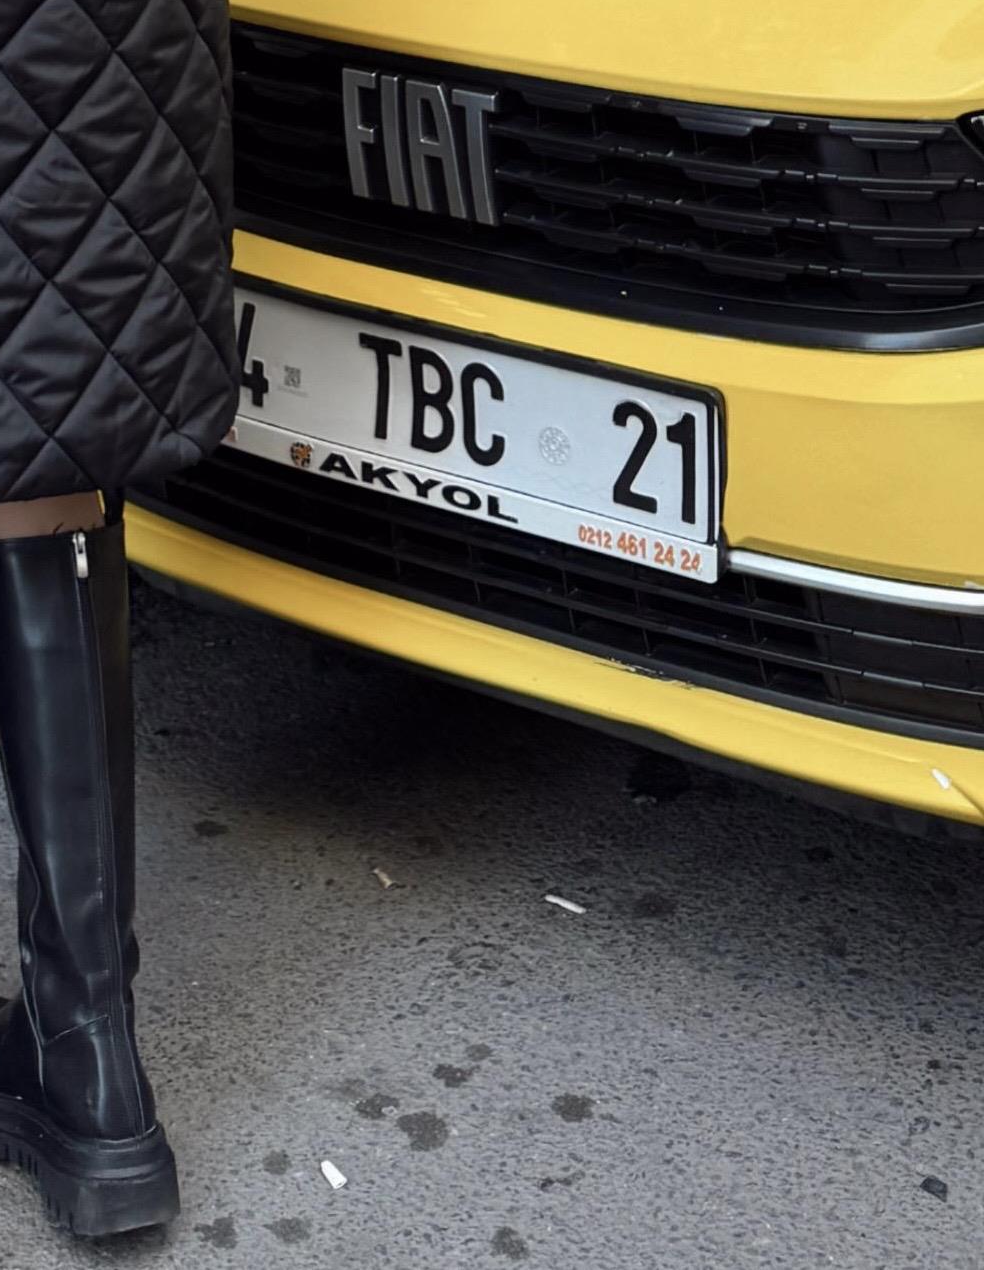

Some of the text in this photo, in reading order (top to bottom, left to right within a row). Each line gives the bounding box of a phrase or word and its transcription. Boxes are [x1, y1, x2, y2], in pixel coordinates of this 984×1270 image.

[342, 67, 500, 226] FIAT
[358, 332, 505, 467] TBC
[613, 401, 697, 525] 21
[319, 452, 519, 524] AKYOL
[578, 524, 613, 550] 0212
[617, 532, 647, 559] 461
[653, 541, 675, 567] 24
